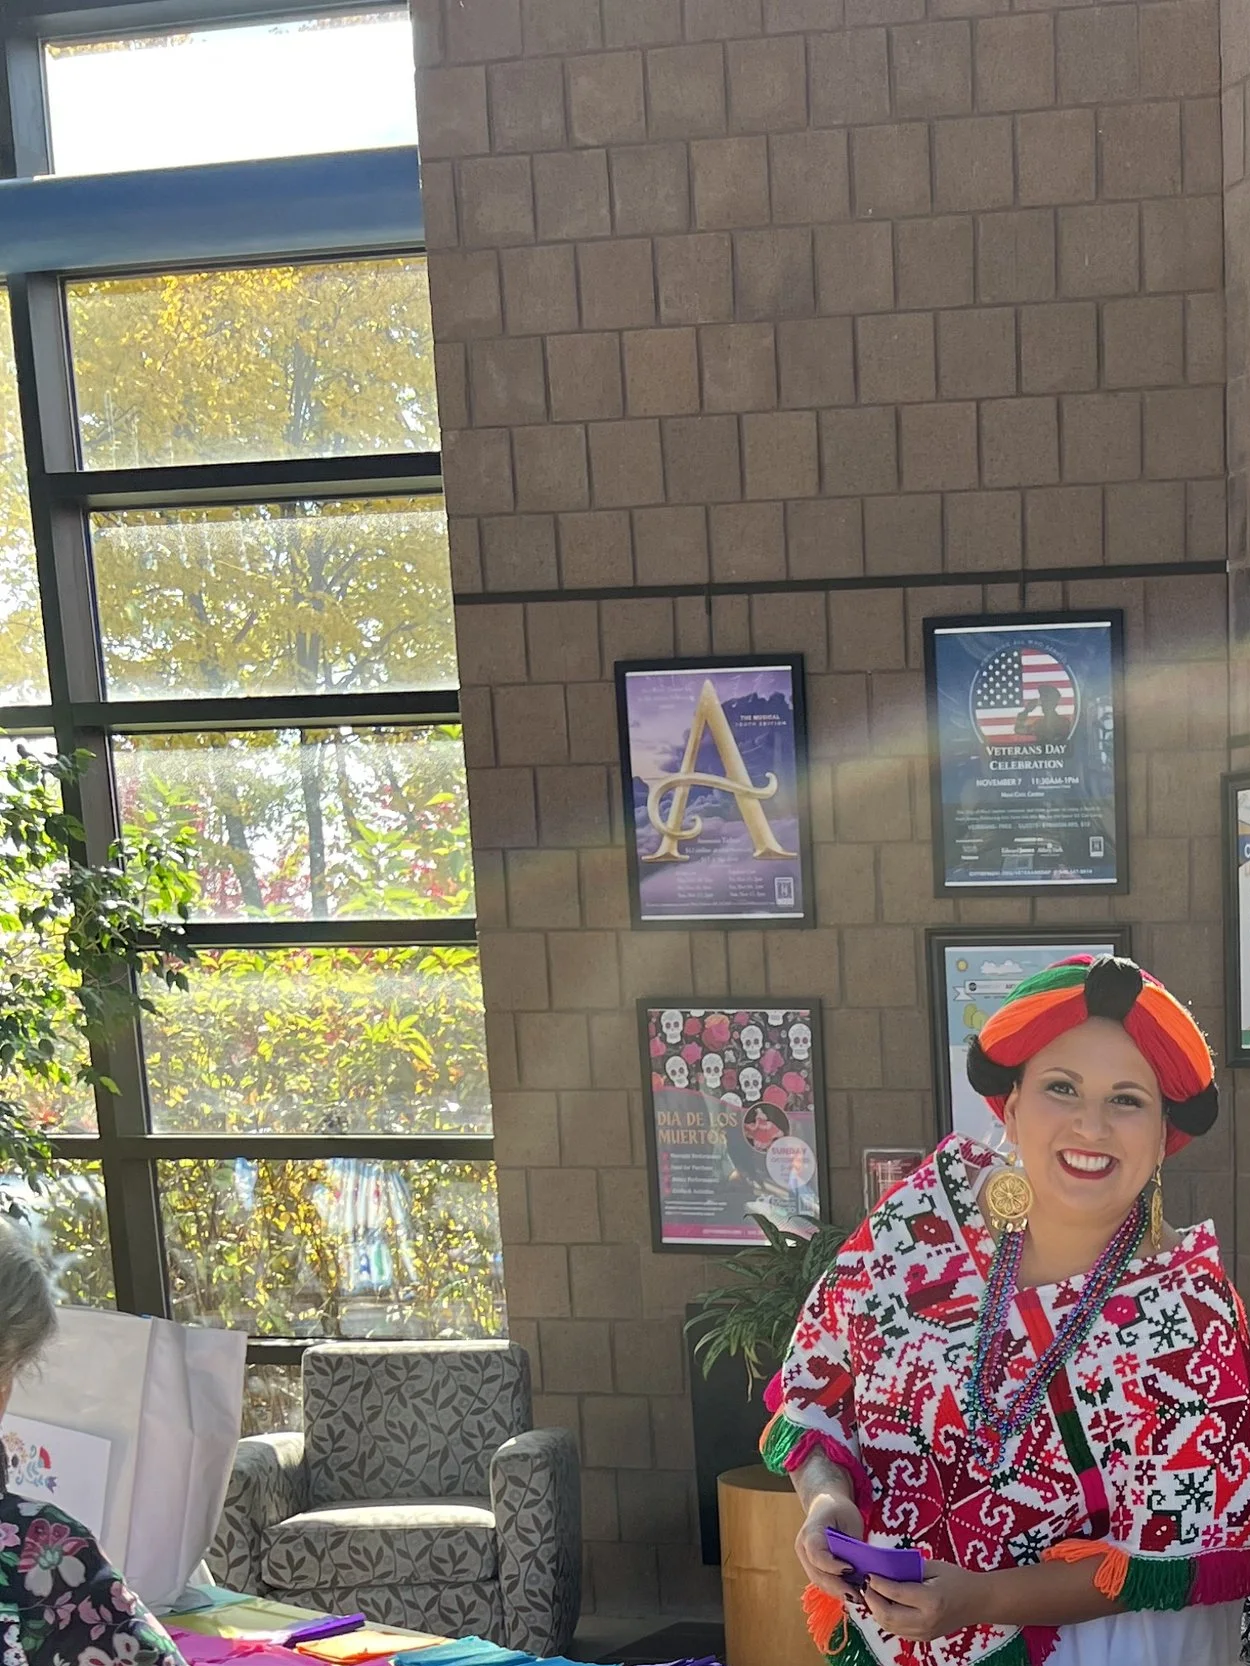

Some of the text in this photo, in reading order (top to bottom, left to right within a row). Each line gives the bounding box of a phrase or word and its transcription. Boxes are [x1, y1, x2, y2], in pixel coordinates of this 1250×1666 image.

[985, 743, 1067, 757] VETERANS DAY
[989, 759, 1064, 771] CELEBRATION
[976, 778, 1017, 788] NOVEMBER
[1017, 778, 1023, 787] 7
[657, 1111, 738, 1128] DIA DE LOS
[657, 1129, 728, 1145] MUERTOS
